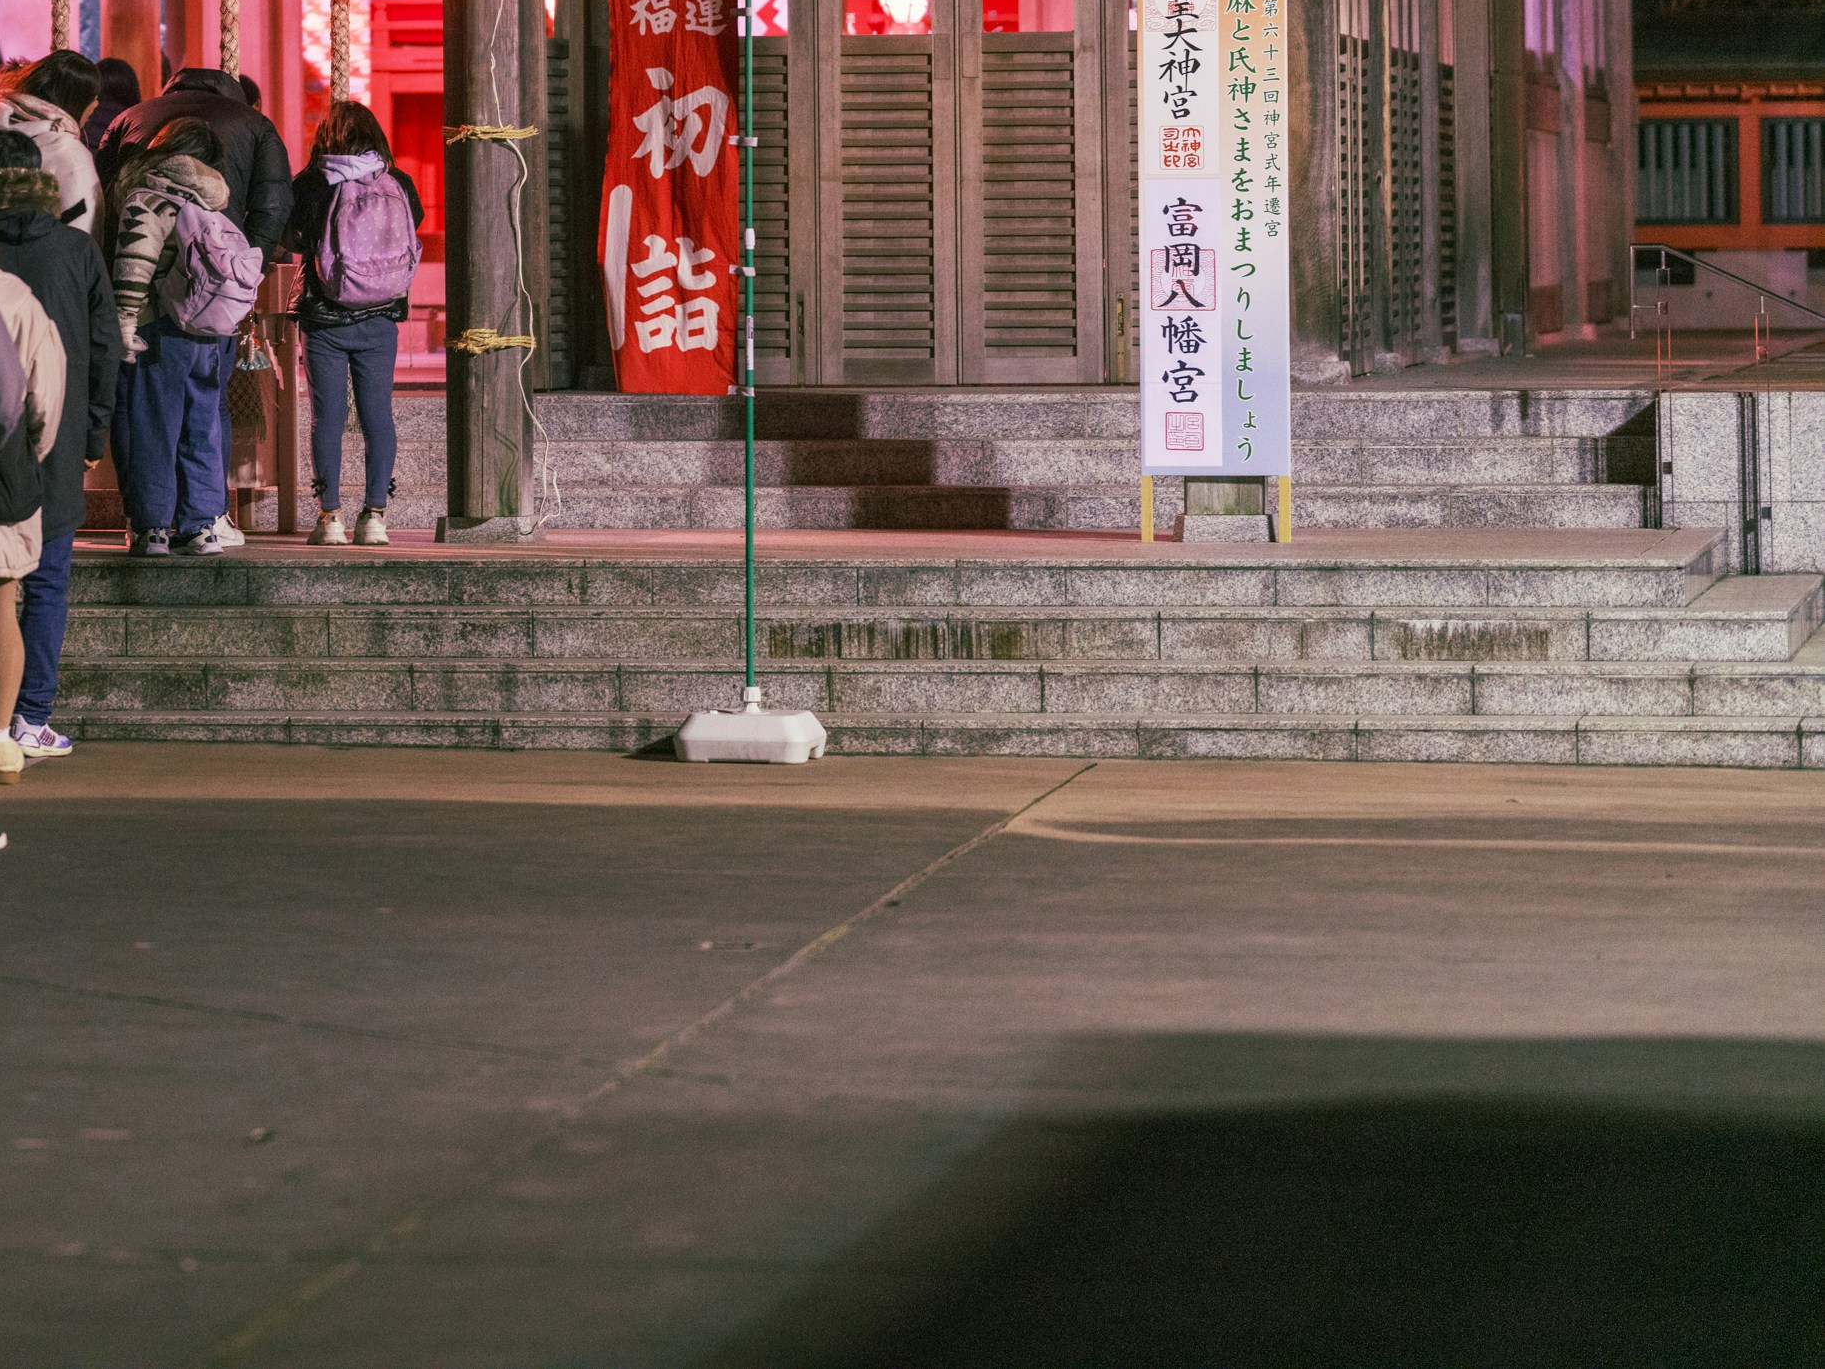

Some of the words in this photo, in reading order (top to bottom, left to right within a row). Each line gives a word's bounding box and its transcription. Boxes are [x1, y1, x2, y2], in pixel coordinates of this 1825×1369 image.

[630, 66, 731, 354] 初詣
[1157, 196, 1208, 404] 富岡八幡宮
